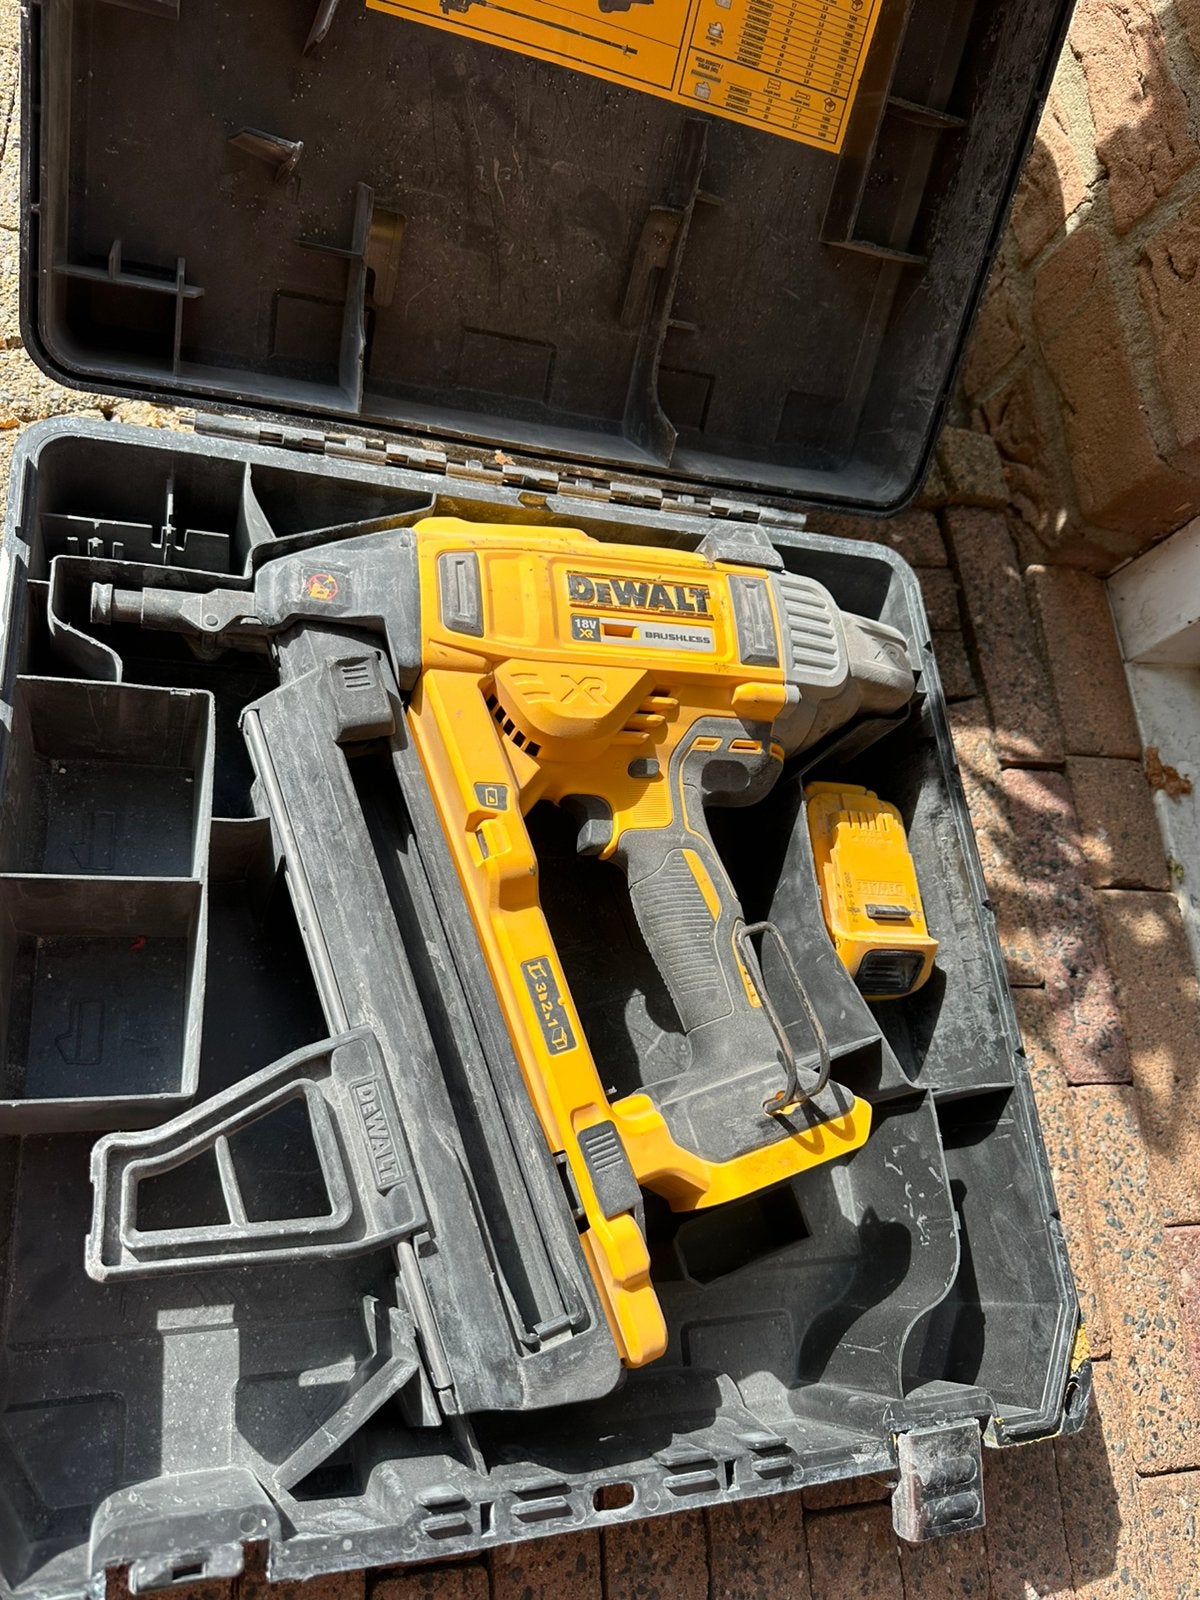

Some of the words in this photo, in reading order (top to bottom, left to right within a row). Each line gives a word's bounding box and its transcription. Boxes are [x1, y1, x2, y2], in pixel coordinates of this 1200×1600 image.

[568, 574, 711, 612] DEWALT
[574, 618, 597, 629] 18V
[579, 629, 594, 639] XR
[645, 631, 711, 644] BRUSHLESS
[560, 674, 613, 706] XR
[535, 981, 548, 993] 3
[540, 1001, 554, 1013] 2
[547, 1018, 559, 1028] 1
[354, 1081, 402, 1184] DEWALT
